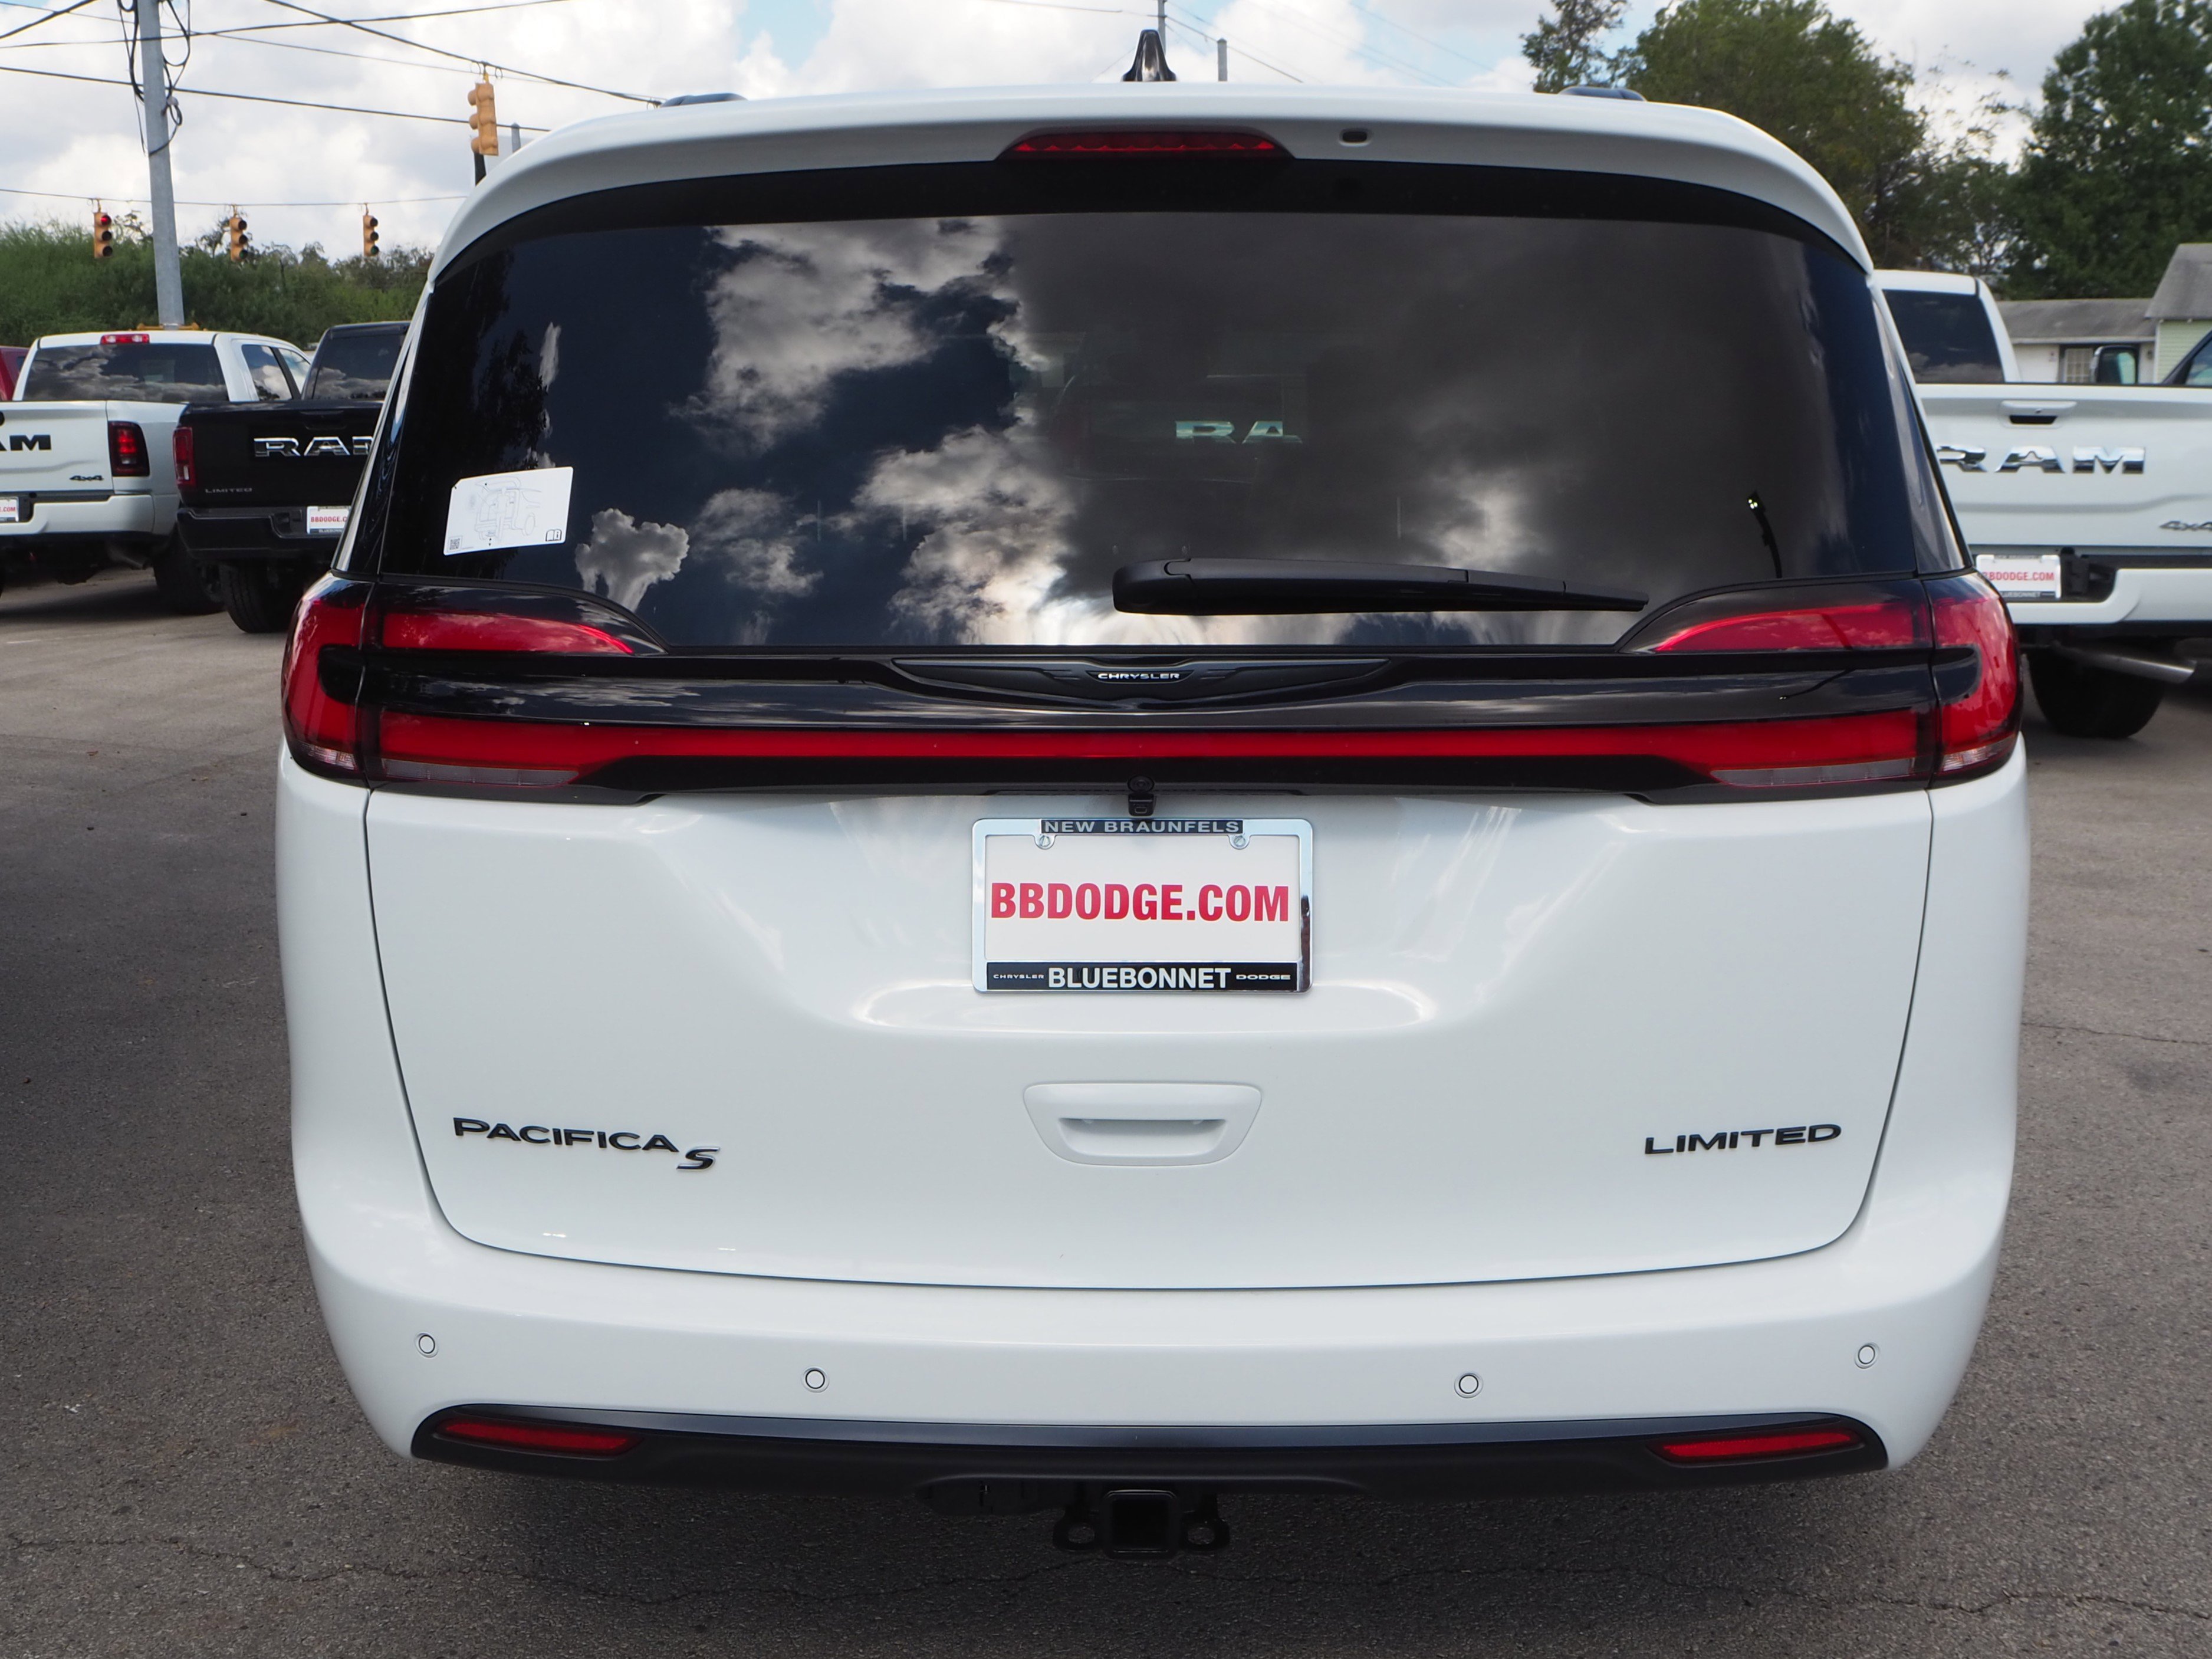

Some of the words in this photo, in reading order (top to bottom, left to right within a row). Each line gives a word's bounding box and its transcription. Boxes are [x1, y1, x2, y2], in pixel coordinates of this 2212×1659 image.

[0, 435, 51, 451] M
[1935, 445, 2146, 474] RAM
[1044, 820, 1095, 833] NEW
[1104, 820, 1240, 833] BRAUNFELS
[991, 882, 1289, 922] BBDODGE.COM
[1048, 967, 1231, 989] BLUEBONNET
[453, 1117, 679, 1152] PACIFICA
[1645, 1123, 1842, 1154] LIMITED
